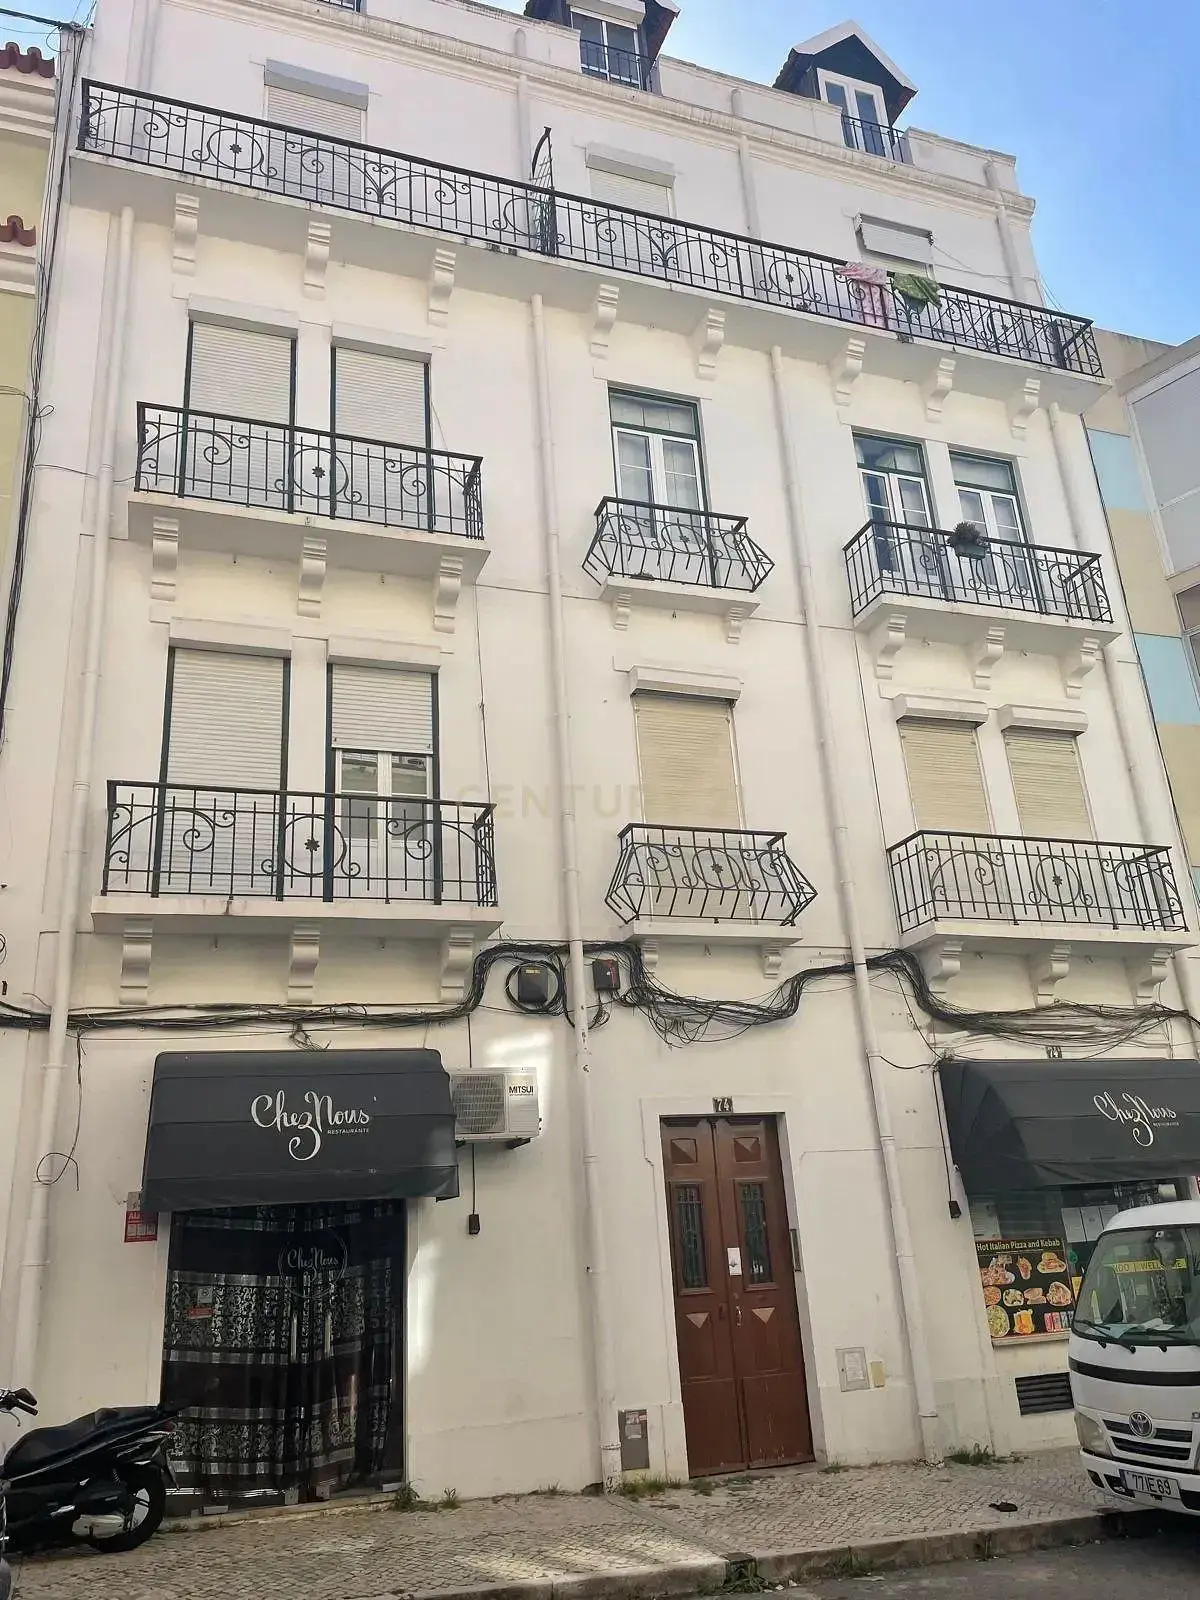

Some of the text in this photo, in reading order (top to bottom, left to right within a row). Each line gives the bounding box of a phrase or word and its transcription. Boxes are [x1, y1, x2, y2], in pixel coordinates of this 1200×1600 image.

[508, 1086, 534, 1094] MITSUI
[251, 1090, 370, 1161] Chez Nous
[1093, 1091, 1177, 1147] Chez Nous
[976, 1238, 1060, 1251] Hot Italian Pizza and Kebab
